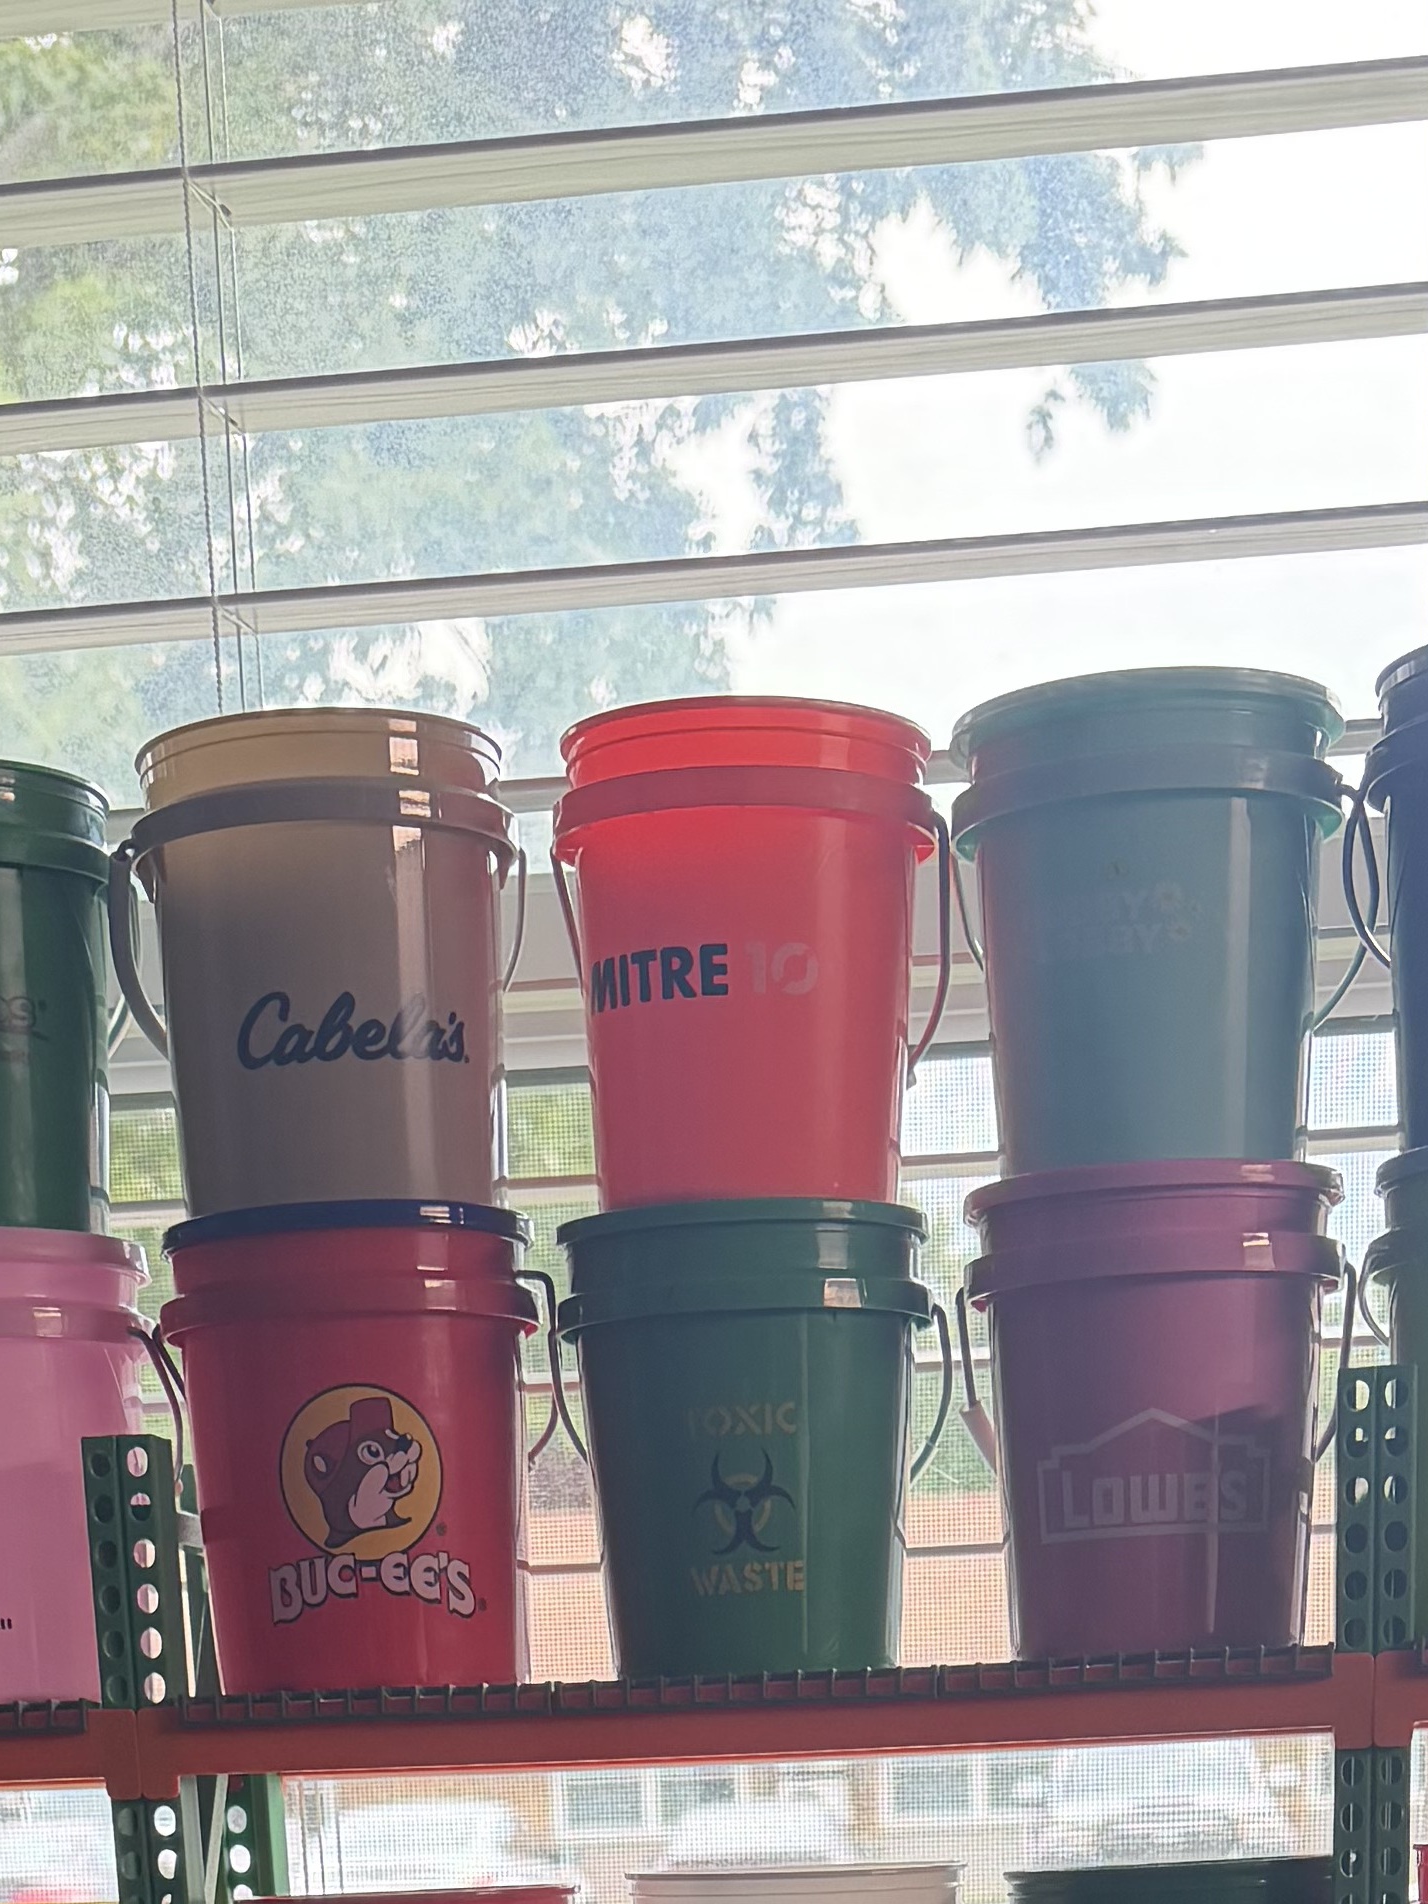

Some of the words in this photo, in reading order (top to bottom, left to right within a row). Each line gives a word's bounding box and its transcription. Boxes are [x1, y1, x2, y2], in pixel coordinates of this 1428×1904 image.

[591, 943, 730, 1016] MITRE
[744, 942, 820, 996] 10
[238, 992, 466, 1071] Cabela's
[1062, 1467, 1248, 1530] LOWES
[689, 1559, 807, 1597] WASTE
